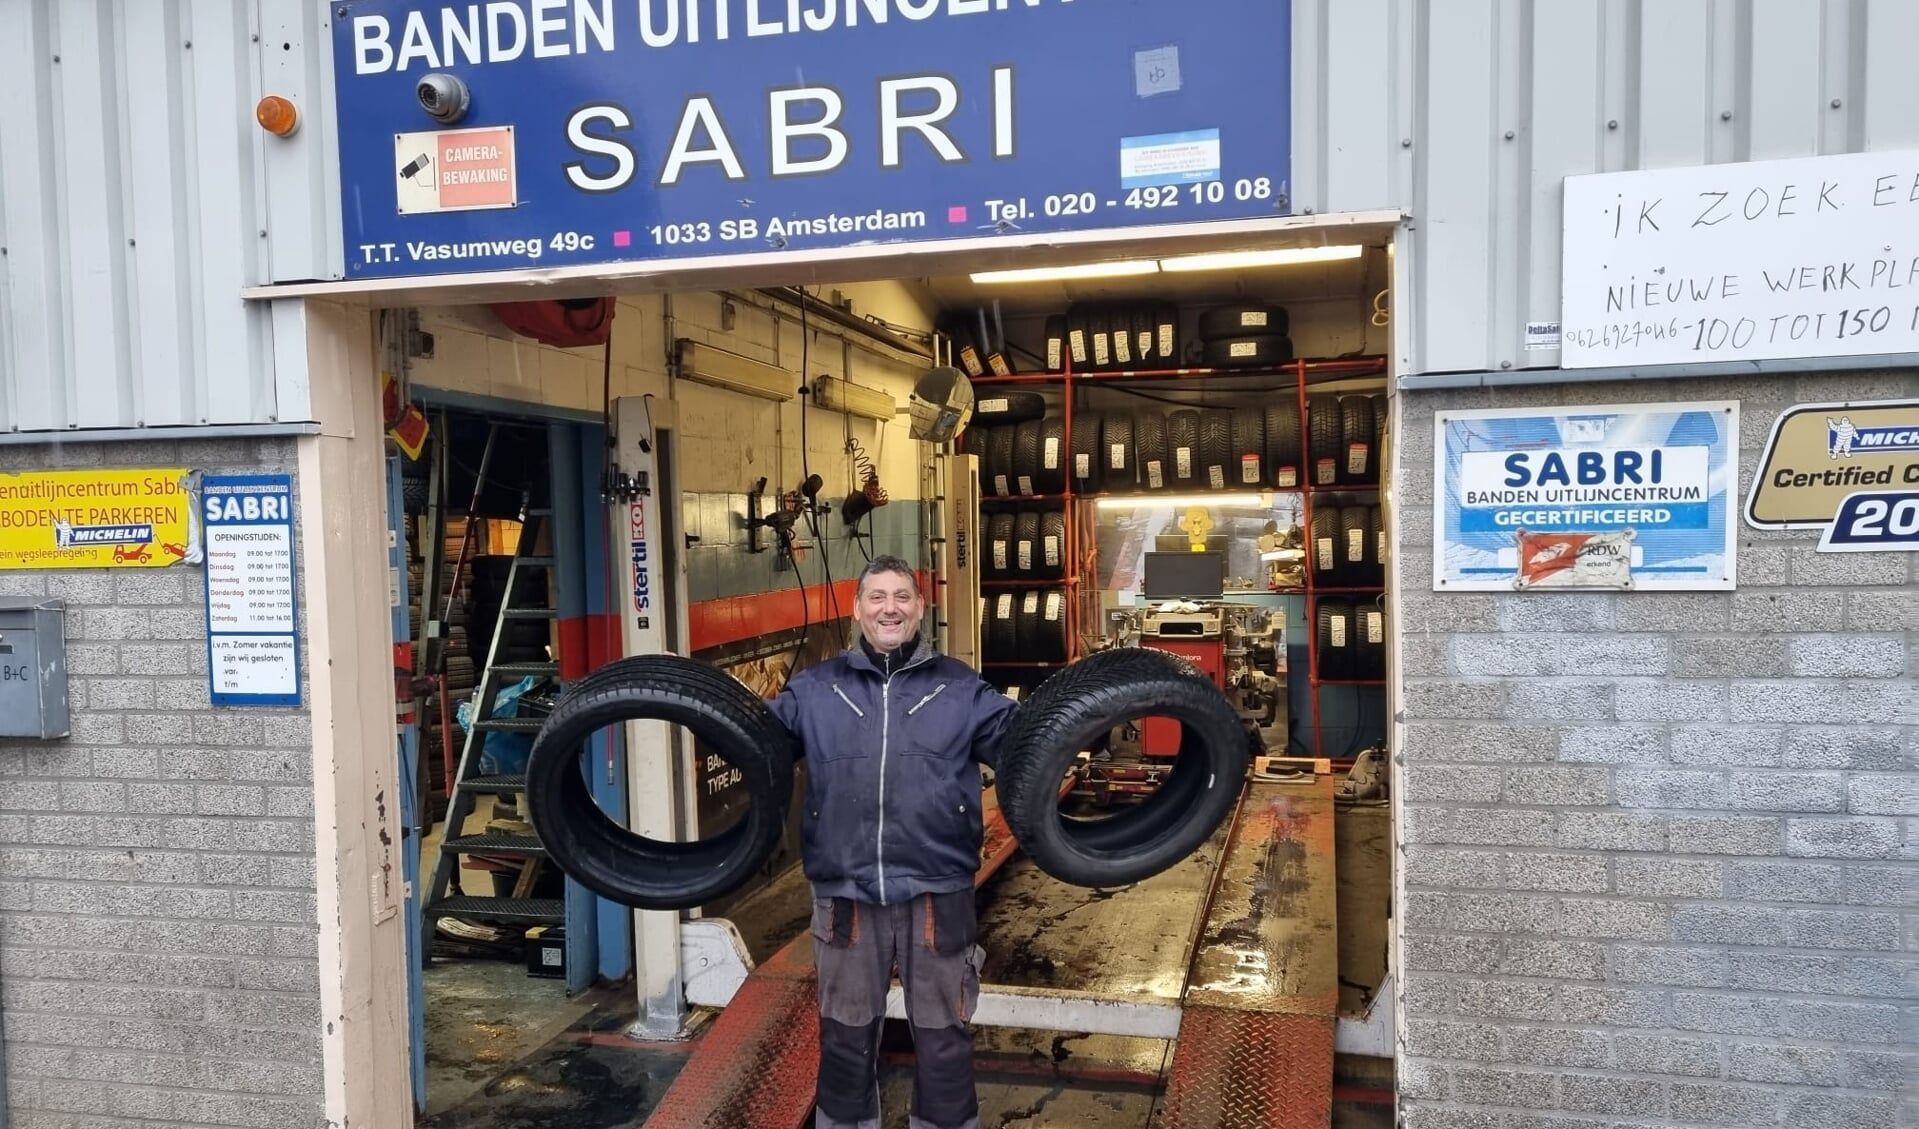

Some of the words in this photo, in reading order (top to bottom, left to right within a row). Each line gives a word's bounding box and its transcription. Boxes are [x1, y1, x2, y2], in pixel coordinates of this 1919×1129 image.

[354, 0, 615, 75] BANDEN
[565, 67, 1013, 191] SABRI
[445, 145, 504, 162] CAMERA-
[442, 168, 508, 185] BEWAKING
[360, 243, 400, 263] T.T.
[407, 237, 542, 260] Vasumweg
[549, 231, 595, 251] 49c
[650, 222, 711, 245] 1033
[719, 218, 758, 240] SB
[765, 208, 926, 238] Amsterdam
[985, 199, 1035, 221] Tel.
[1044, 192, 1096, 216] 020
[1124, 185, 1178, 210] 492
[1189, 181, 1224, 204] 10
[1234, 177, 1271, 201] 08
[1769, 313, 1828, 343] TOT
[1836, 305, 1891, 340] 150
[1504, 449, 1662, 488] SABRI
[1773, 465, 1894, 488] Certified
[1467, 490, 1539, 504] BANDEN
[1546, 486, 1701, 503] UITLIJNCENTRUM
[64, 508, 84, 526] TE
[90, 505, 177, 527] PARKEREN
[206, 495, 288, 521] SABRI
[1494, 508, 1671, 526] GECERTIFICEERD
[1850, 499, 1919, 536] 20
[75, 528, 149, 541] MICHELIN
[956, 531, 967, 569] stertil
[1587, 544, 1621, 556] RDW
[631, 542, 650, 612] stertil
[250, 654, 284, 664] gesloten
[4, 665, 28, 681] B+C
[707, 771, 729, 795] TYPE
